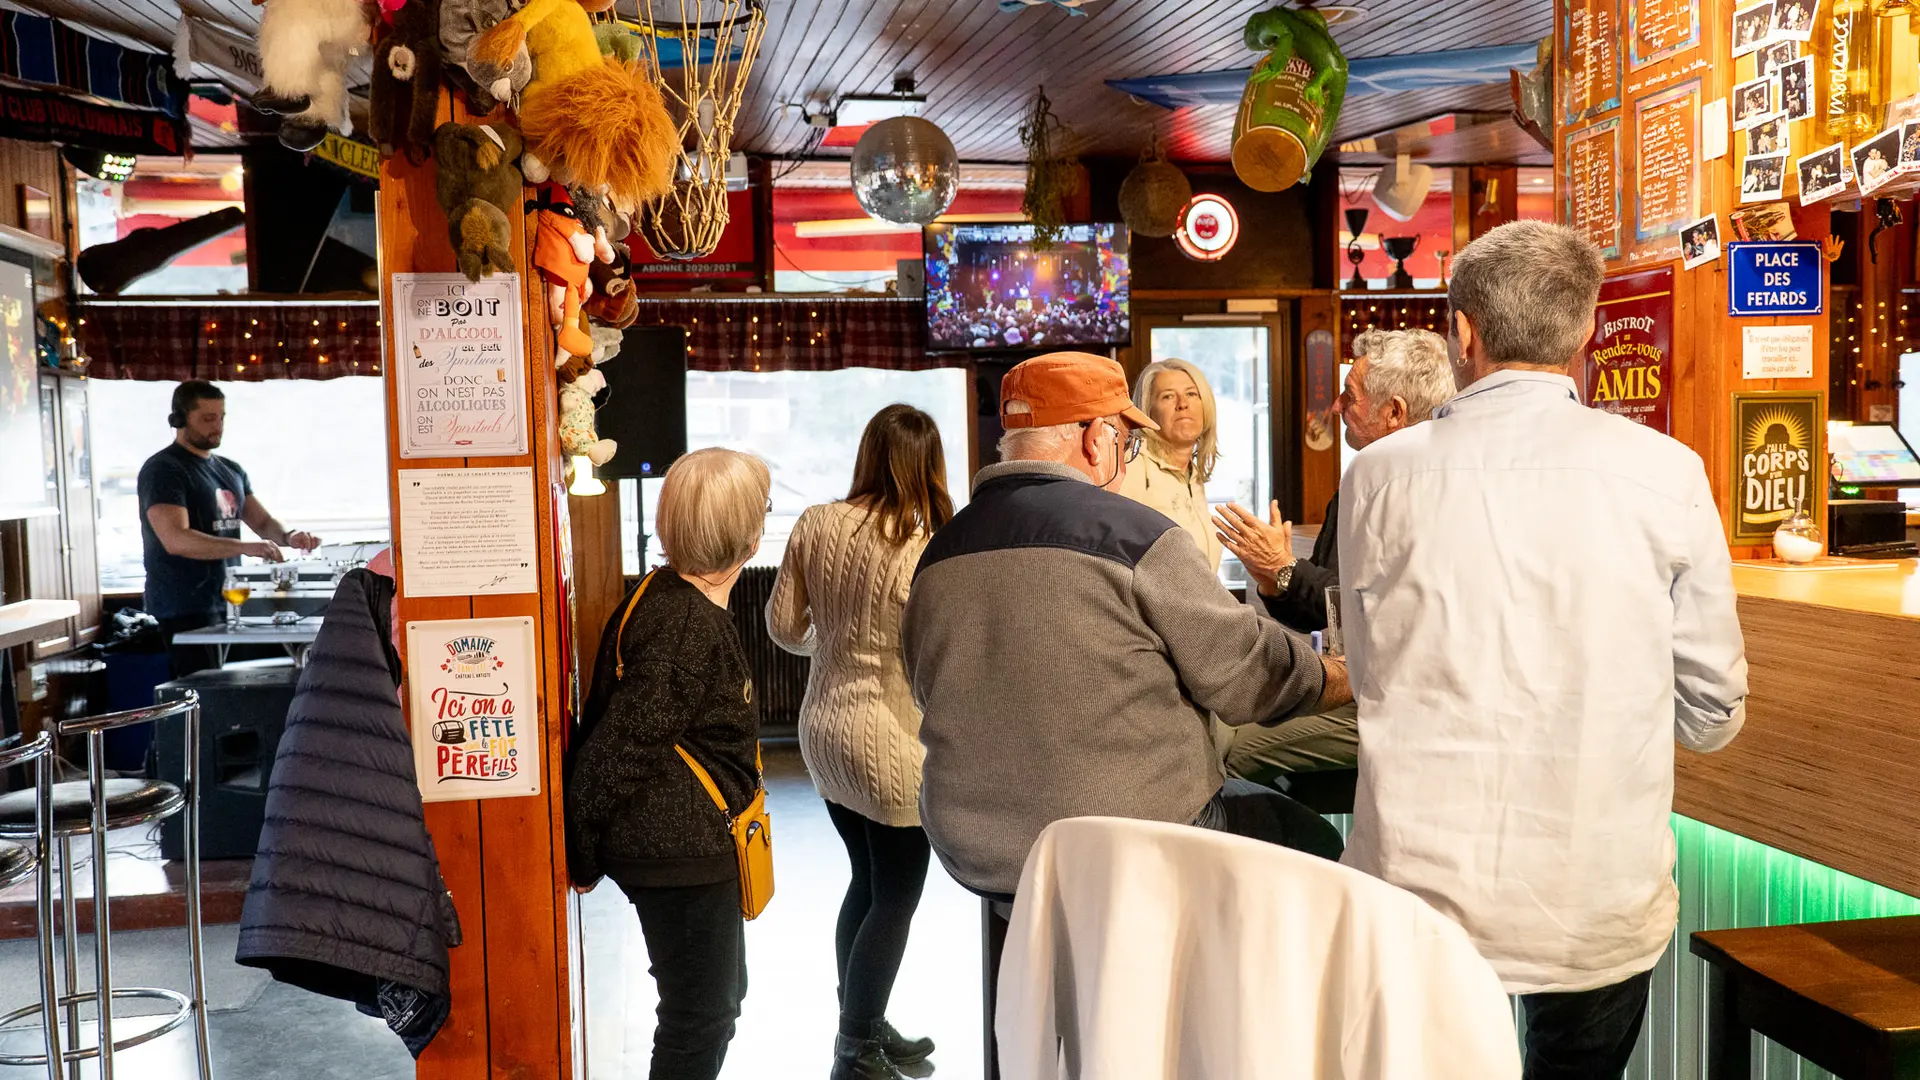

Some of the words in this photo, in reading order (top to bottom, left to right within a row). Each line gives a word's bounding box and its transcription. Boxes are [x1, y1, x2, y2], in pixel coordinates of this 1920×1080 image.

[7, 96, 47, 123] CLUB
[48, 99, 143, 138] TOULONNAIS
[322, 138, 380, 174] ICLER
[1755, 252, 1799, 267] PLACE
[1763, 272, 1791, 286] DES
[447, 284, 465, 296] ICI
[416, 299, 432, 307] ON
[1747, 291, 1807, 306] FETARDS
[417, 307, 431, 316] NE
[434, 298, 501, 316] BOIT
[450, 318, 467, 327] Pas
[1603, 315, 1655, 339] BISTROT
[419, 326, 503, 341] D'ALCOOL
[480, 343, 502, 352] boit
[1592, 335, 1663, 367] Rendez-vous
[418, 358, 435, 369] des
[443, 375, 483, 386] DONC
[1592, 365, 1661, 402] AMIS
[417, 387, 439, 399] ON
[446, 386, 476, 398] N'EST
[482, 386, 506, 398] PAS
[416, 399, 507, 413] ALCOOLIQUES
[416, 415, 434, 425] ON
[418, 424, 434, 434] EST
[1764, 443, 1778, 454] J'AI
[1778, 443, 1788, 452] LE
[1743, 448, 1810, 478] CORPS
[1745, 474, 1806, 511] DIEU
[446, 637, 495, 656] DOMAINE
[431, 687, 467, 720] Ici
[471, 697, 497, 716] on
[501, 698, 515, 716] a
[469, 715, 516, 741] FÊTE
[437, 745, 490, 777] PÈRE
[491, 757, 518, 776] FILS
